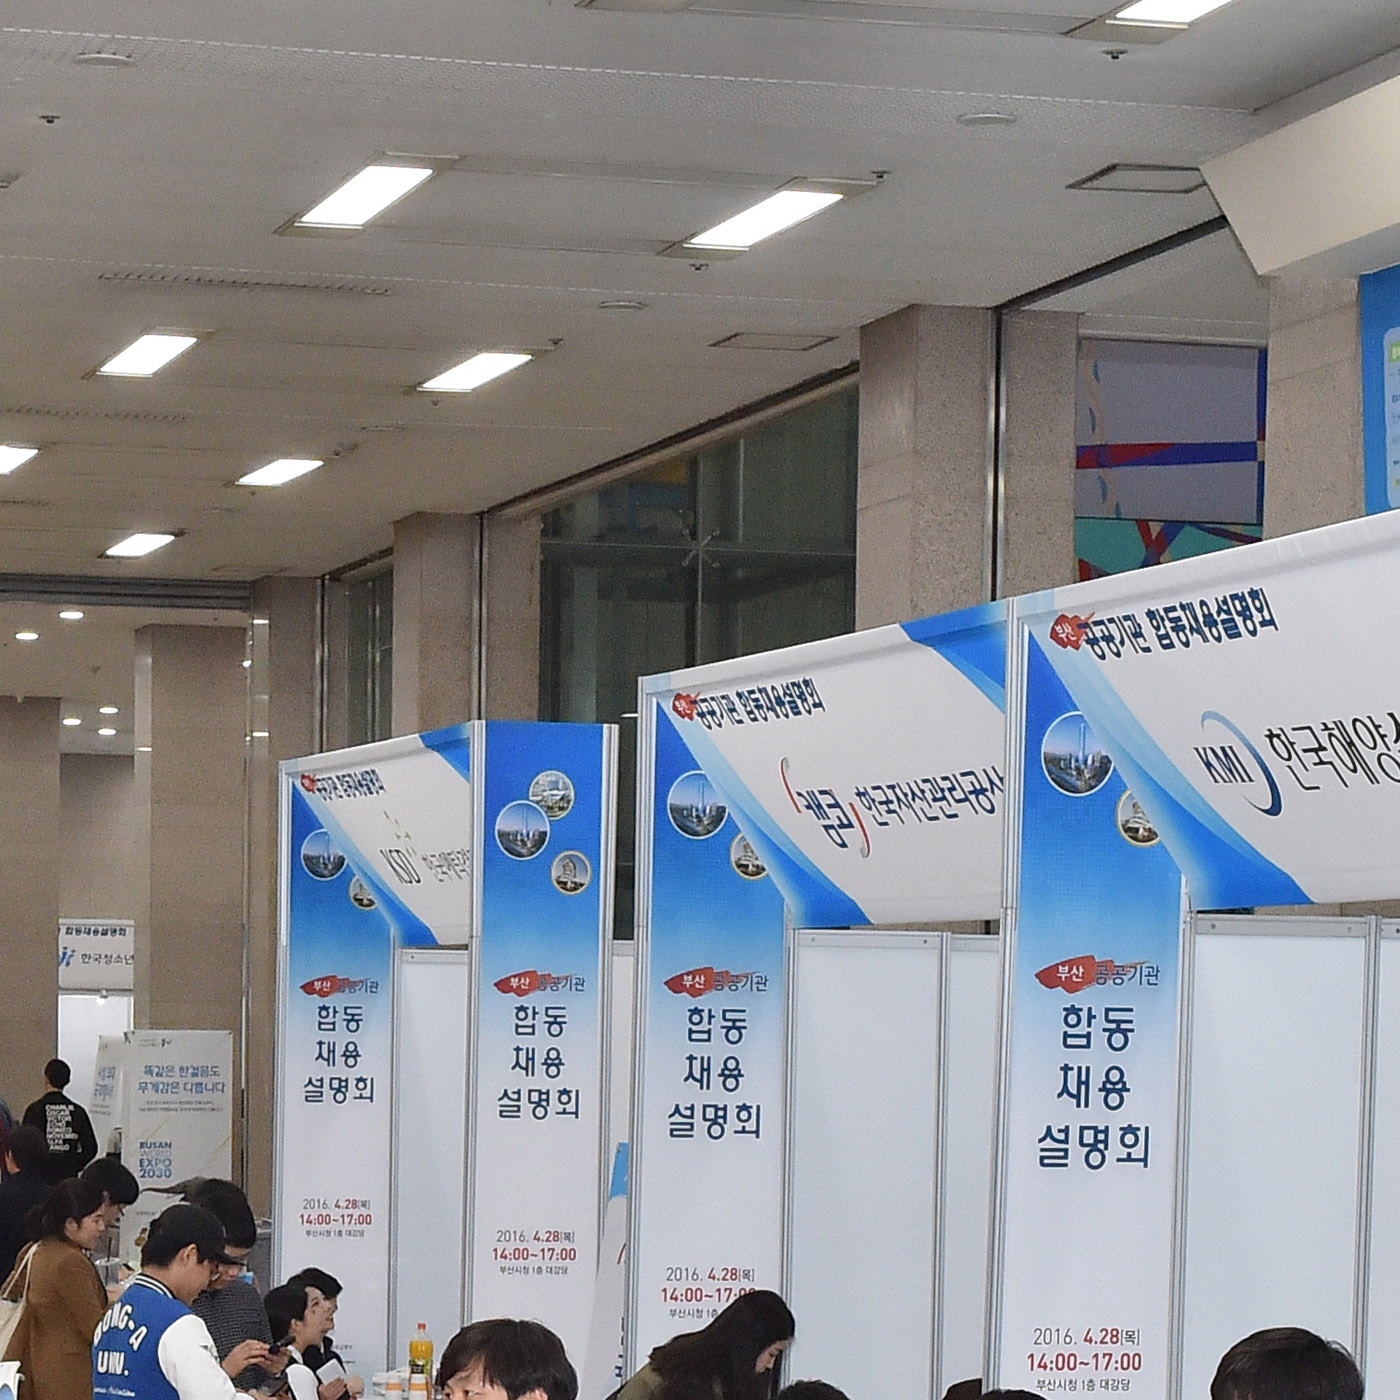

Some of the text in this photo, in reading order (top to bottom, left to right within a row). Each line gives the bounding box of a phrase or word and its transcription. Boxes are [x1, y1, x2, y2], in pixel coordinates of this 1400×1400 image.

[1076, 612, 1153, 661] 공공기관
[1144, 586, 1280, 651] 합동채용설명회
[692, 677, 826, 731] 공공기관 합동채용설명회
[1194, 745, 1255, 785] KMI
[855, 765, 1004, 828] 한국자산관리공사
[379, 849, 422, 884] KSD
[80, 953, 135, 966] 한국청소년
[312, 978, 332, 992] 부산
[508, 975, 586, 993] 부산 공공기관
[681, 973, 769, 993] 부산 공공기관
[1056, 965, 1161, 987] 부산 공공기관
[316, 1004, 365, 1034] 합동
[513, 1004, 568, 1038] 합동
[686, 1006, 749, 1046] 합동
[1061, 1003, 1136, 1052] 합동
[314, 1039, 363, 1069] 채용
[510, 1046, 566, 1079] 채용
[682, 1053, 745, 1093] 채용
[303, 1075, 376, 1105] 설명회
[1056, 1062, 1131, 1112] 채용
[497, 1087, 581, 1121] 설명회
[667, 1102, 762, 1141] 설명회
[1037, 1123, 1151, 1170] 설명회
[139, 1158, 173, 1169] EXPO
[139, 1168, 173, 1179] 2030
[302, 1198, 330, 1211] 2016.
[299, 1213, 373, 1226] 14:00~17:00
[496, 1230, 530, 1243] 2016.
[492, 1247, 577, 1262] 14:00~17:00
[499, 1265, 531, 1275] 부산시청
[545, 1265, 569, 1275] 대강당
[666, 1267, 703, 1282] 2016.
[669, 1308, 704, 1319] 부산시청
[1032, 1328, 1078, 1346] 2016.
[1026, 1351, 1143, 1372] 14:00~17:00
[1036, 1377, 1078, 1393] 부산시청
[1099, 1376, 1132, 1392] 대강당
